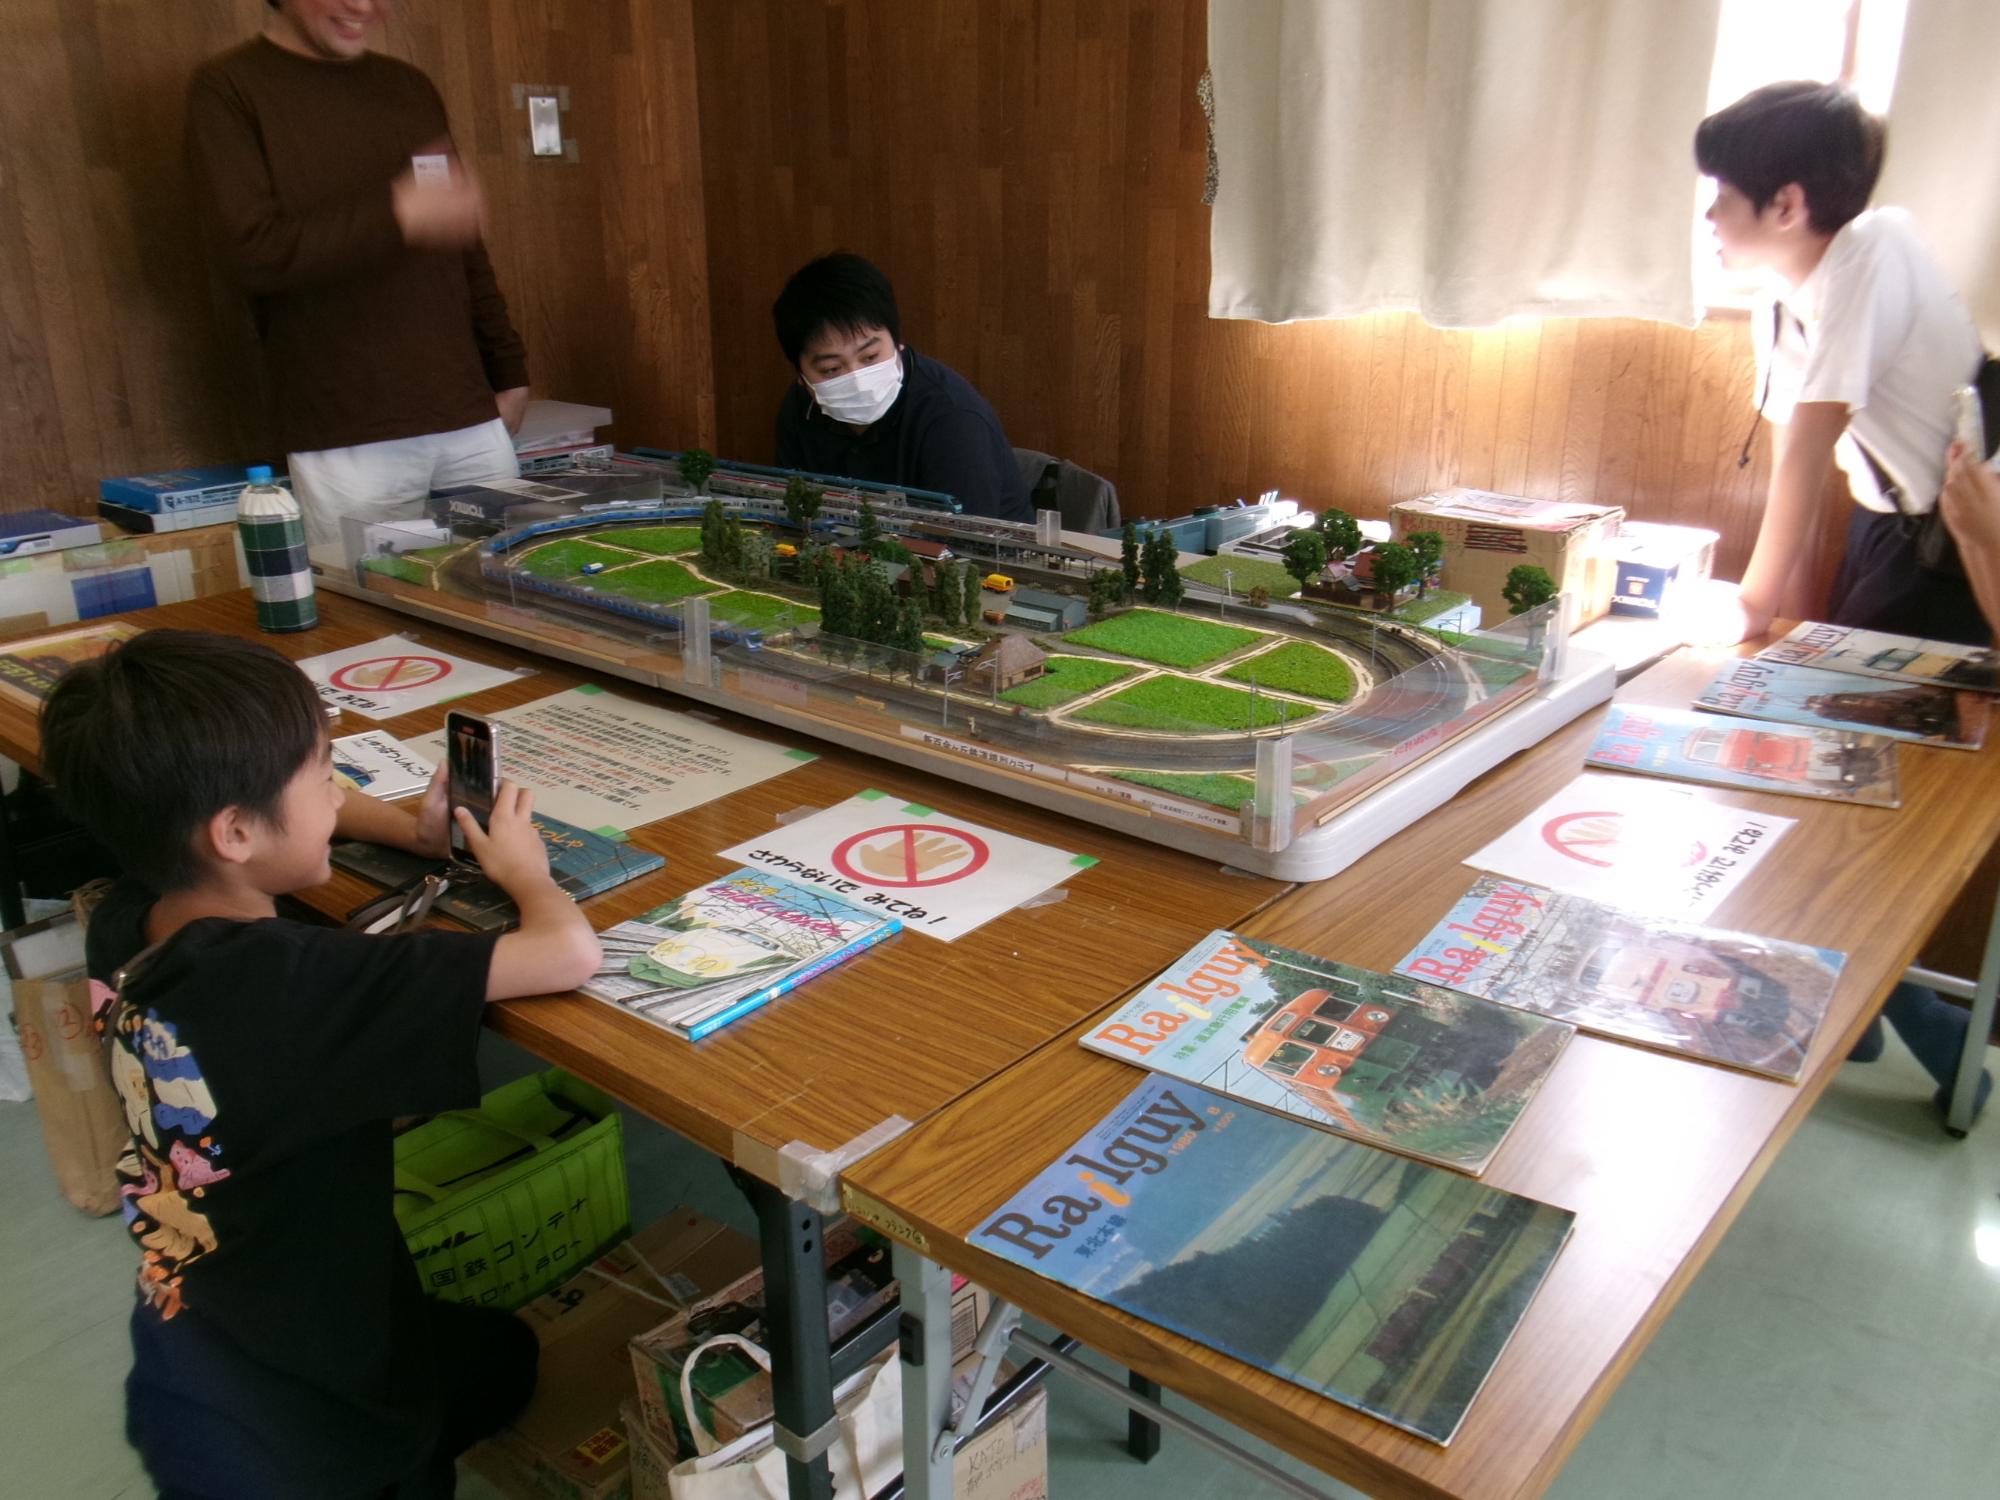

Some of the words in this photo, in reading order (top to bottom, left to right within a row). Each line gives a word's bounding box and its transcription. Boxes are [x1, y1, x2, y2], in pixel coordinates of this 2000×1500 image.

[748, 850, 862, 894] さわらないで
[1407, 883, 1543, 985] Railguy
[1094, 938, 1271, 1056] Railguy
[980, 1090, 1207, 1260] Railguy
[431, 1198, 590, 1288] 国鉄コンテナ
[1074, 1214, 1128, 1258] 東北本線
